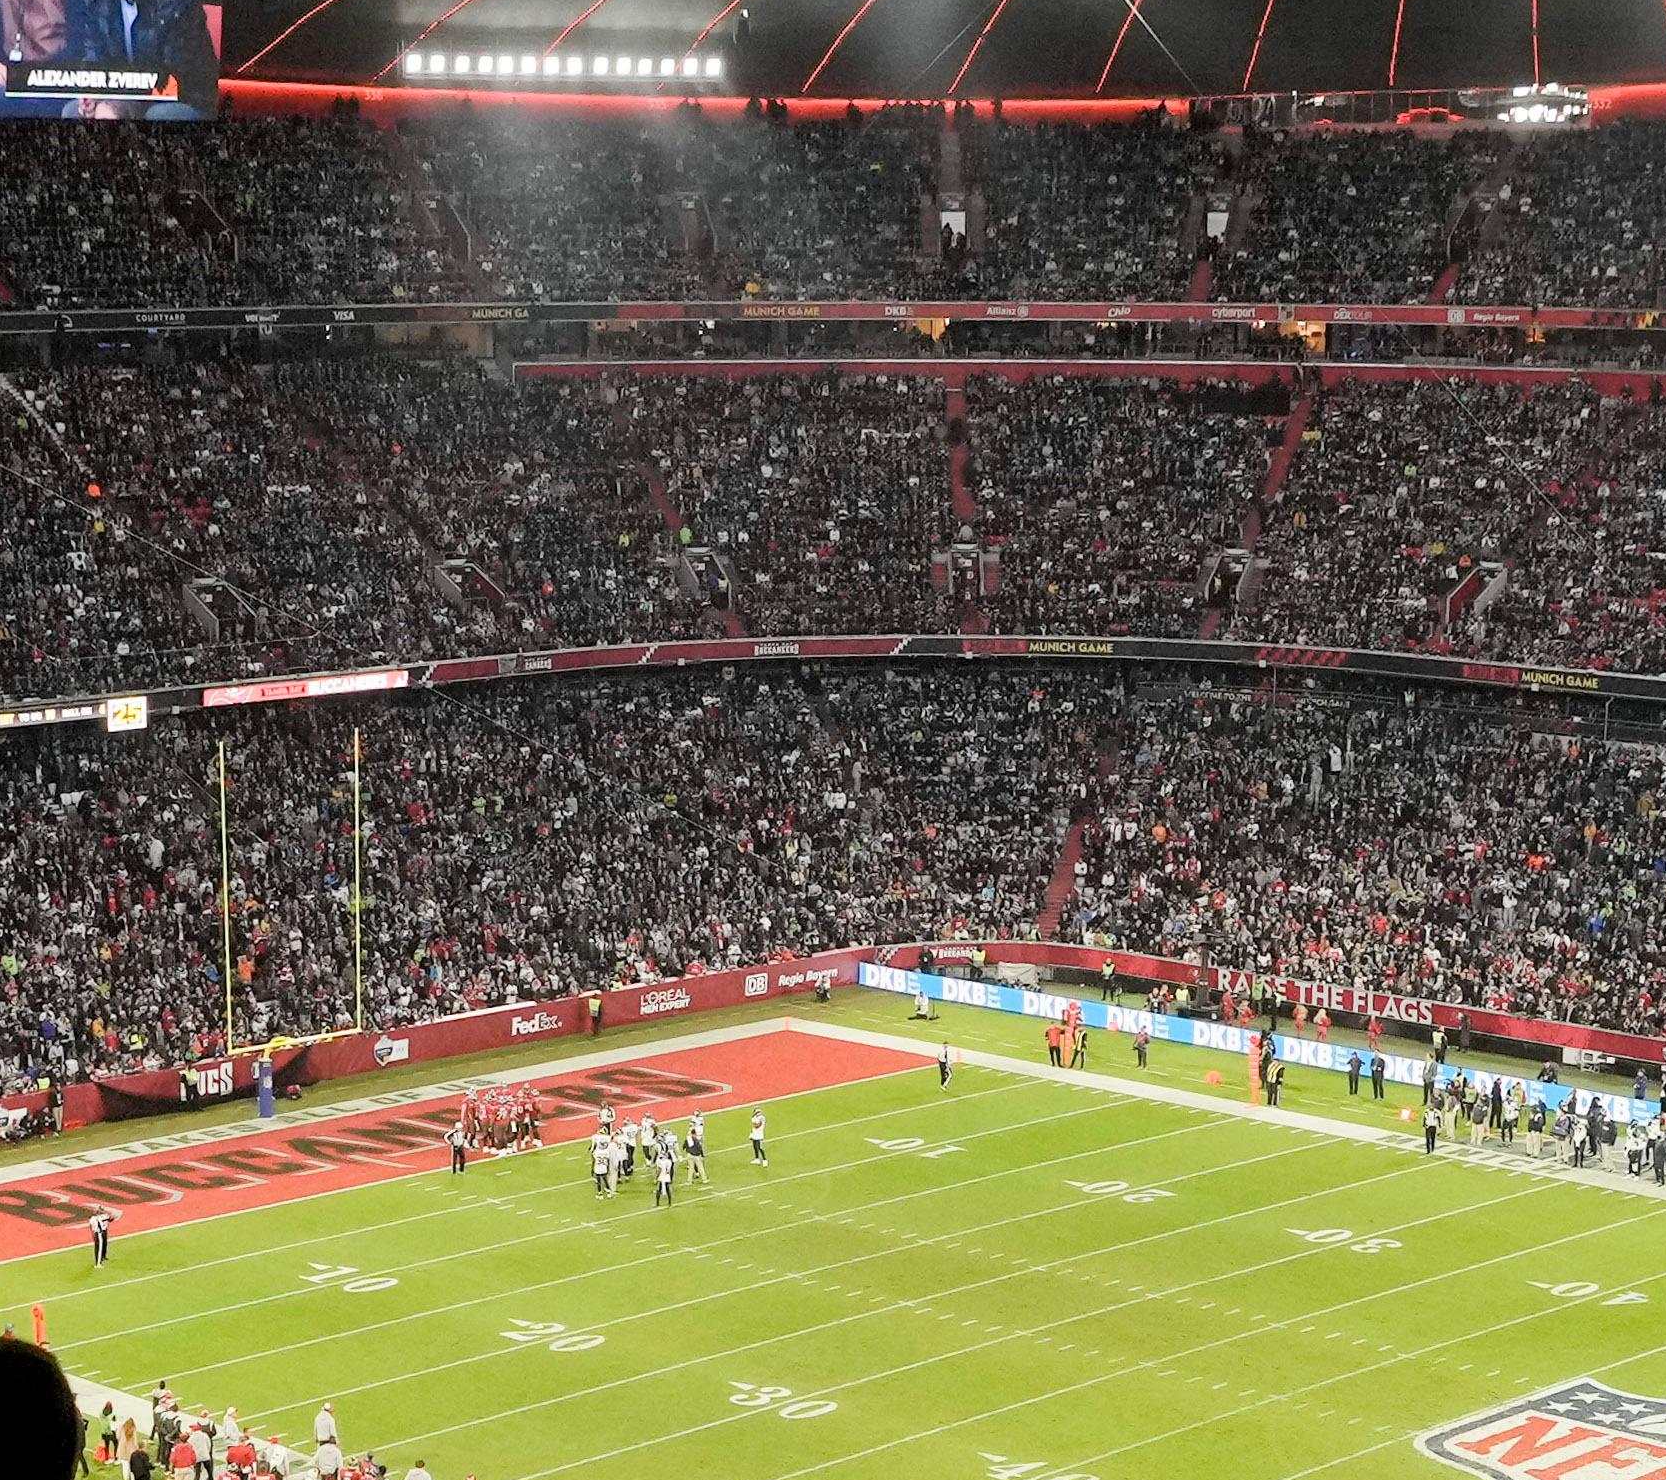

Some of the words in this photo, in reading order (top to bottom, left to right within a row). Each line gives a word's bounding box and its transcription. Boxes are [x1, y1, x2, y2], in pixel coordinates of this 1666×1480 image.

[27, 70, 106, 87] ALEXANDER
[108, 72, 157, 90] ZVEREV
[334, 310, 354, 320] VISA
[472, 308, 513, 319] MUNICH
[744, 306, 784, 317] MUNICH
[787, 306, 820, 317] GAME
[986, 306, 1016, 317] Allianz
[1212, 307, 1256, 319] cyberport
[1029, 642, 1076, 653] MUNICH
[1078, 642, 1114, 654] GAME
[1521, 671, 1564, 687] MUNICH
[1566, 675, 1599, 689] GAME
[778, 973, 804, 988] Regio
[806, 968, 838, 985] Bayern
[866, 966, 907, 994] DKB
[942, 977, 987, 1007] DKB
[1297, 981, 1344, 1012] THE
[1353, 991, 1434, 1026] FLAGS
[511, 1012, 558, 1037] FedEx
[1106, 1004, 1153, 1034] DKB
[1193, 1021, 1241, 1050] DKB
[1283, 1036, 1333, 1071] DKB
[372, 1091, 425, 1109] OF
[881, 1136, 968, 1160] 10
[1079, 1179, 1176, 1203] 20
[1306, 1228, 1403, 1254] 30
[300, 1263, 400, 1294] 10
[1550, 1281, 1649, 1307] 40
[498, 1320, 605, 1352] 20
[734, 1384, 839, 1419] 30
